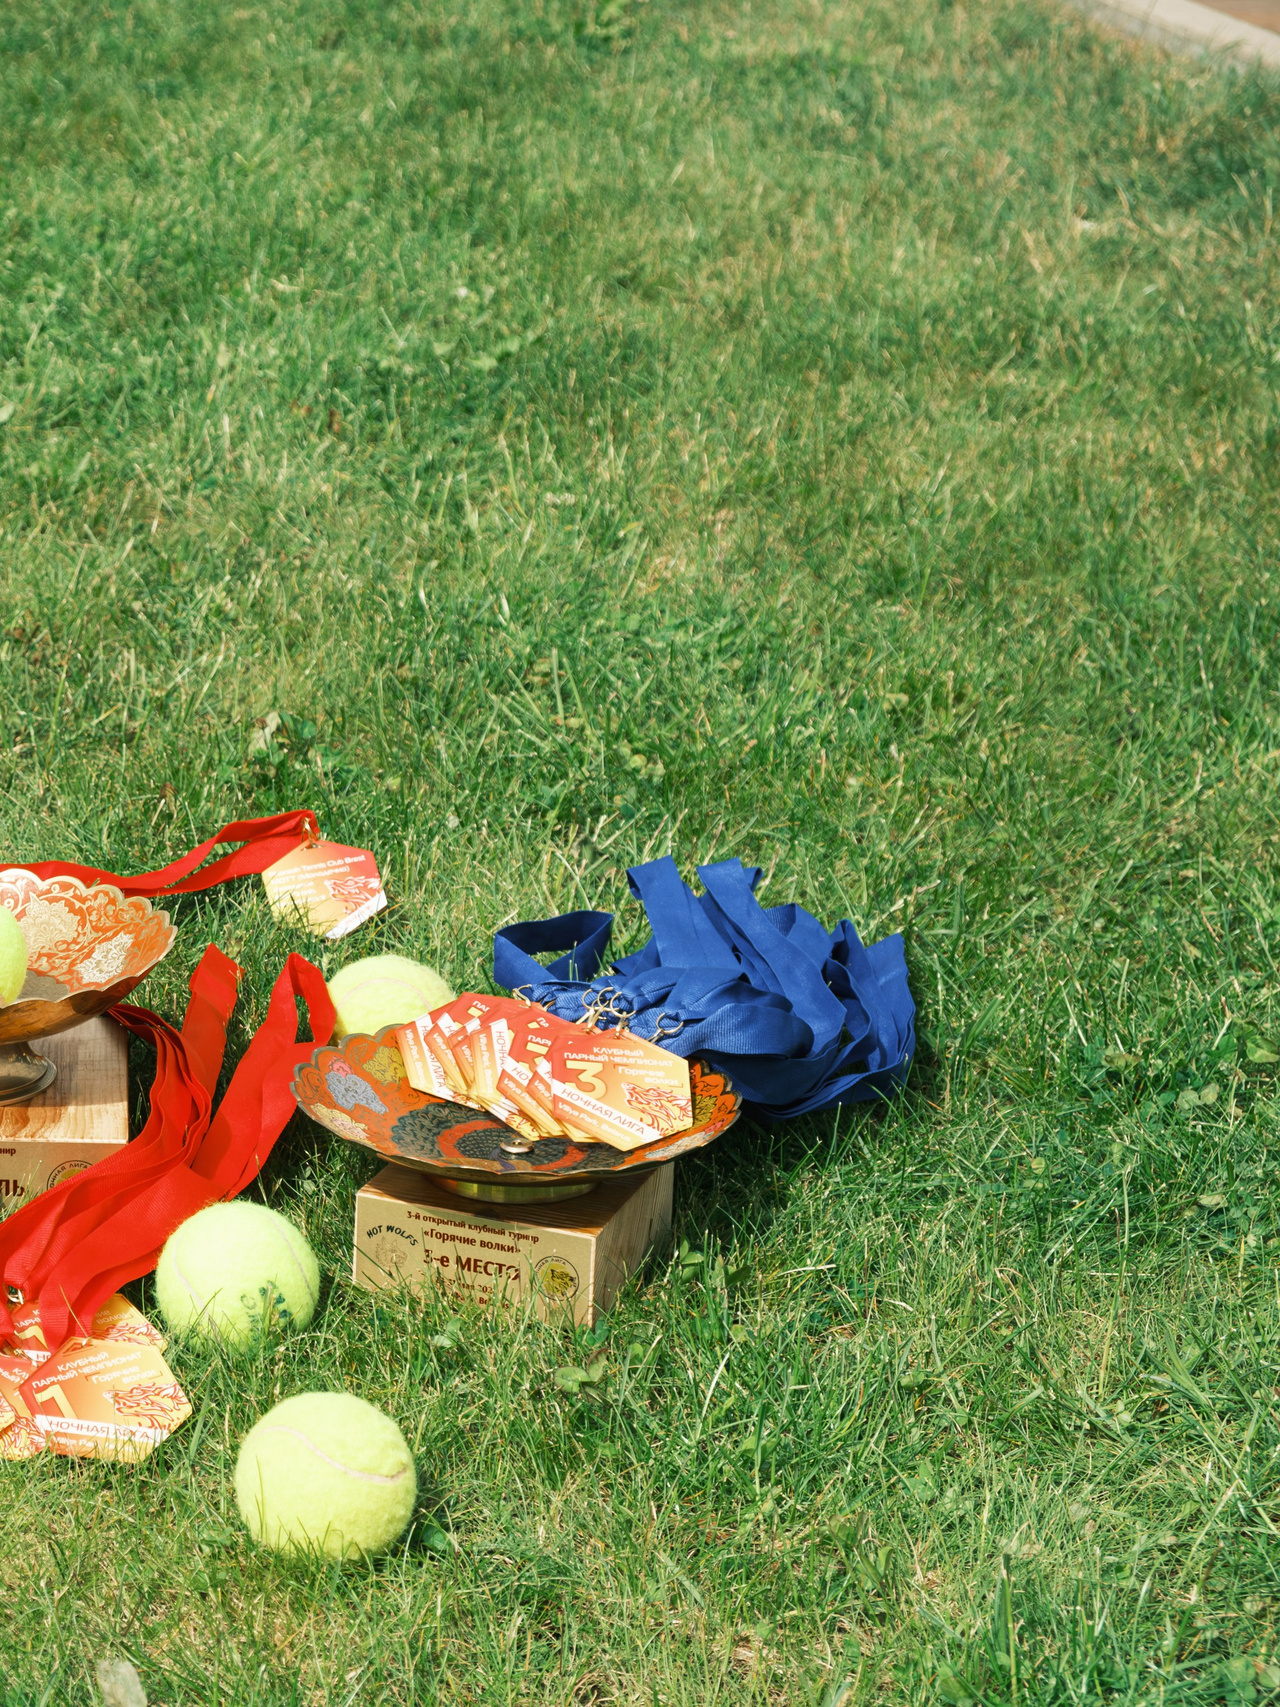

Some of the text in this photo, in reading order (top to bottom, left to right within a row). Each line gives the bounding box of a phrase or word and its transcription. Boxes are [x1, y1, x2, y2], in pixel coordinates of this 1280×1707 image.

[327, 859, 344, 868] Club
[344, 855, 366, 864] Brest
[495, 1030, 508, 1068] НОЧНА
[564, 1052, 674, 1067] ПАРНЫЙ ЧЕМПИОНАТ
[593, 1047, 644, 1057] КЛУБНЫЙ
[431, 1064, 446, 1088] ЛИГА
[565, 1060, 607, 1100] 3
[618, 1066, 665, 1077] Горячие
[644, 1077, 678, 1085] волки
[561, 1088, 613, 1118] НОЧНАЯ
[613, 1113, 645, 1136] ЛИГА
[49, 1166, 67, 1189] ОЧНАЯ
[366, 1225, 419, 1246] HOT WOLFS
[407, 1210, 540, 1245] 3-й открытый клубный турнир
[423, 1228, 521, 1254] «Горячие волки»
[456, 1255, 520, 1281] МЕСТО
[32, 1369, 78, 1389] ПАРНЫЙ
[79, 1351, 143, 1374] ЧЕМПИОНАТ
[57, 1351, 109, 1372] КЛУБНЫЙ
[91, 1365, 140, 1384] Горячие
[122, 1369, 157, 1384] волки
[34, 1384, 78, 1419] 1
[49, 1420, 109, 1436] НОЧНАЯ
